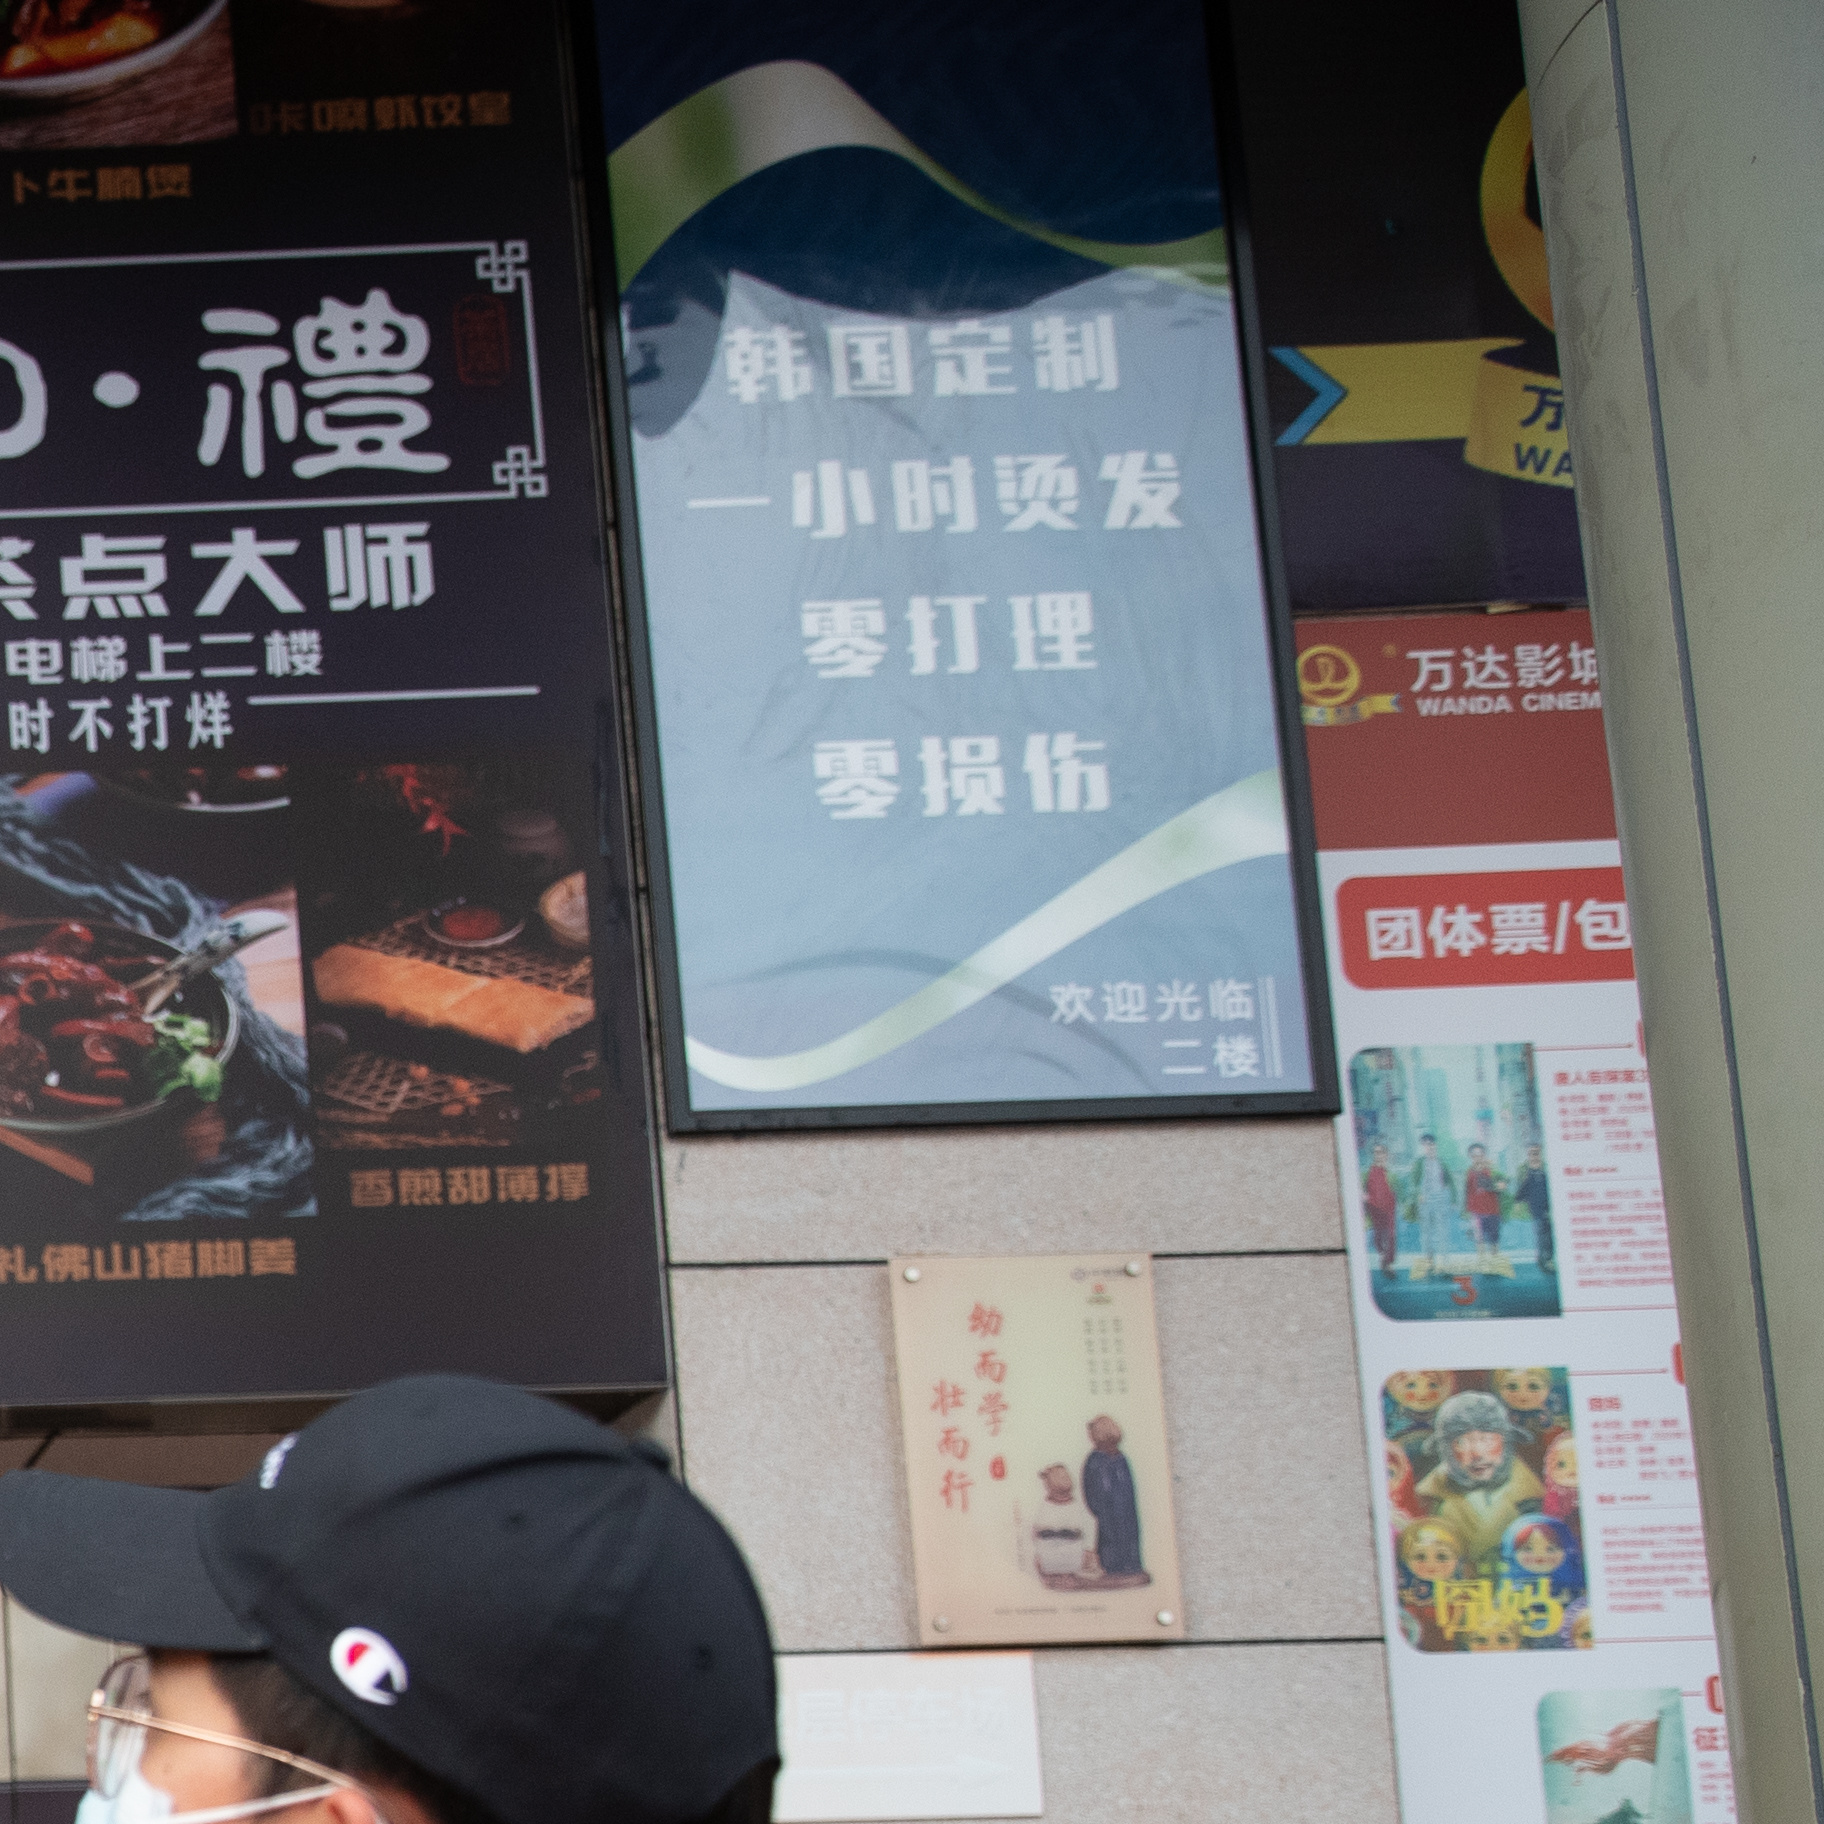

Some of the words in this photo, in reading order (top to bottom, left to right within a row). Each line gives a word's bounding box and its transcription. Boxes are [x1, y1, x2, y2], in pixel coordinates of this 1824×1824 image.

[724, 314, 1121, 404] 韩国定制
[687, 451, 1185, 540] 一小时烫发
[801, 591, 1098, 678] 零打理
[1416, 694, 1514, 717] WANDA
[813, 732, 1111, 821] 零损伤
[1365, 898, 1632, 961] 团体票/包
[1049, 978, 1255, 1026] 欢迎光临
[1163, 1034, 1263, 1079] 二楼
